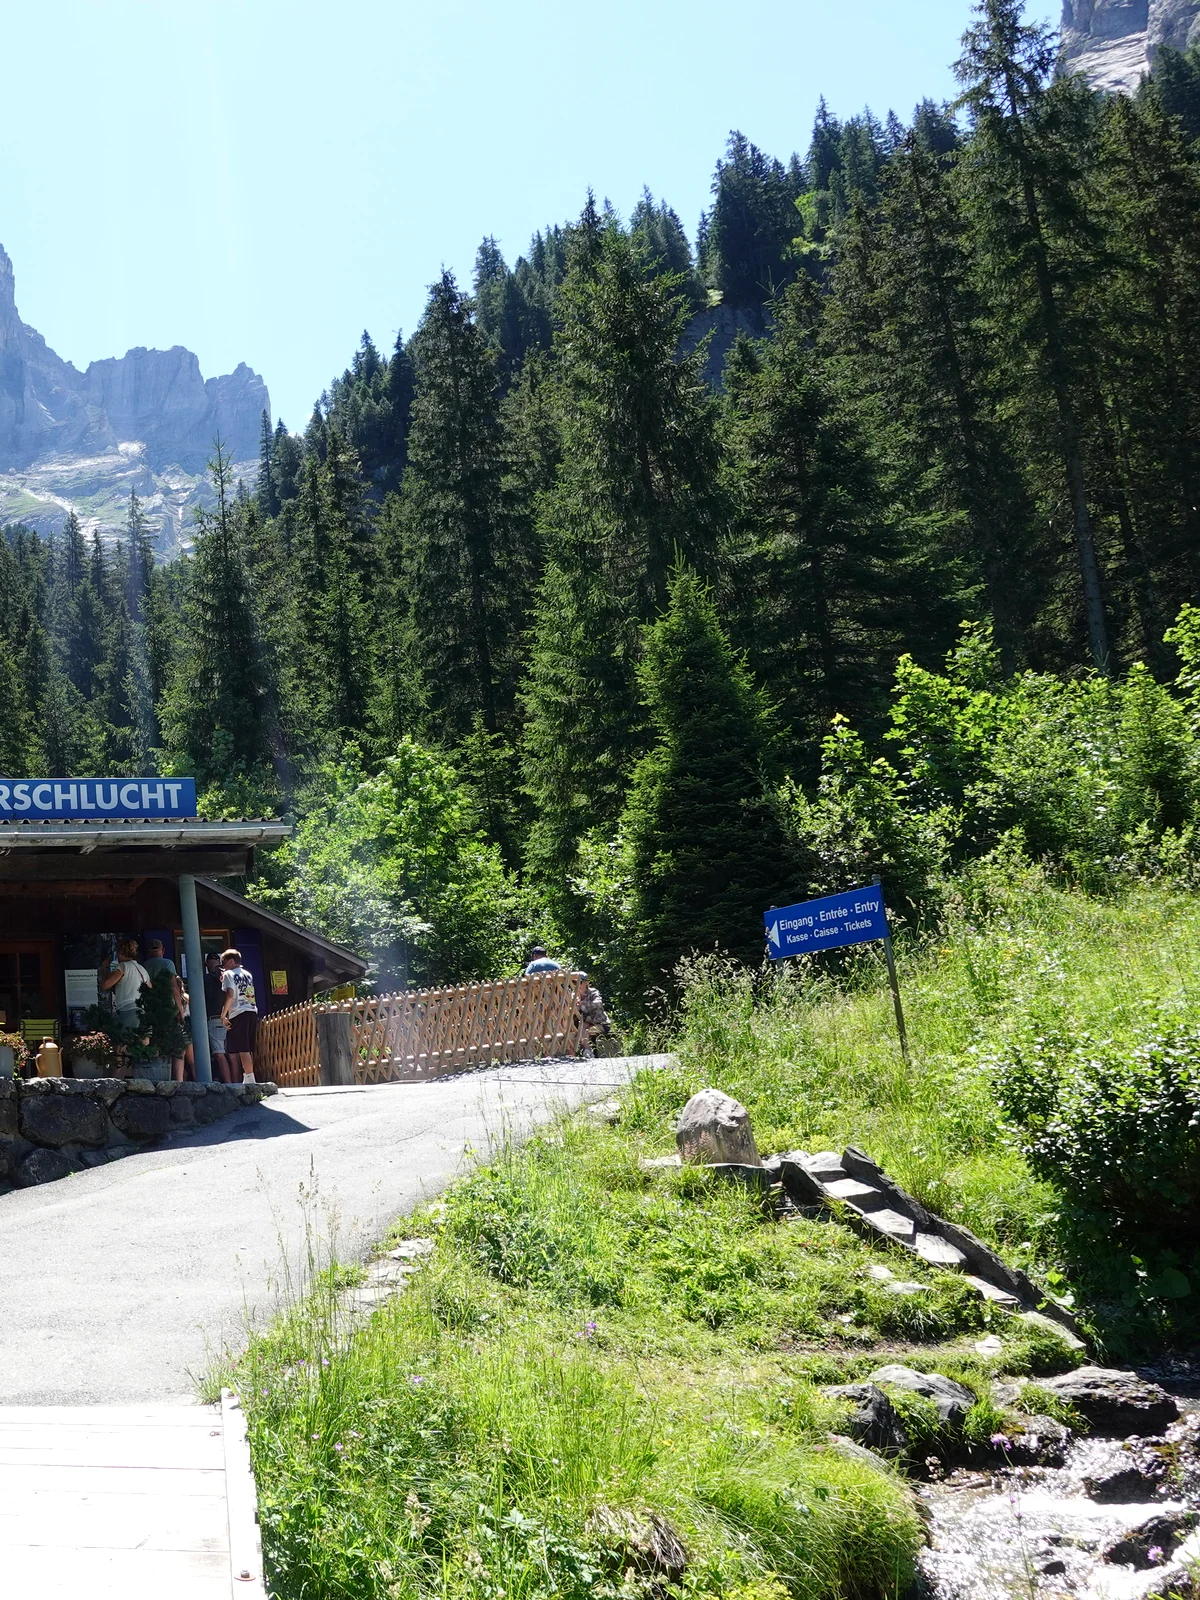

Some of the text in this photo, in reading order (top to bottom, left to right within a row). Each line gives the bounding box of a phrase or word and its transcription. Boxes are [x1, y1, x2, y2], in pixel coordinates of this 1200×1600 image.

[779, 900, 879, 931] Eingang Entrée Entry
[786, 918, 872, 944] Kasse Caisse Tickets
